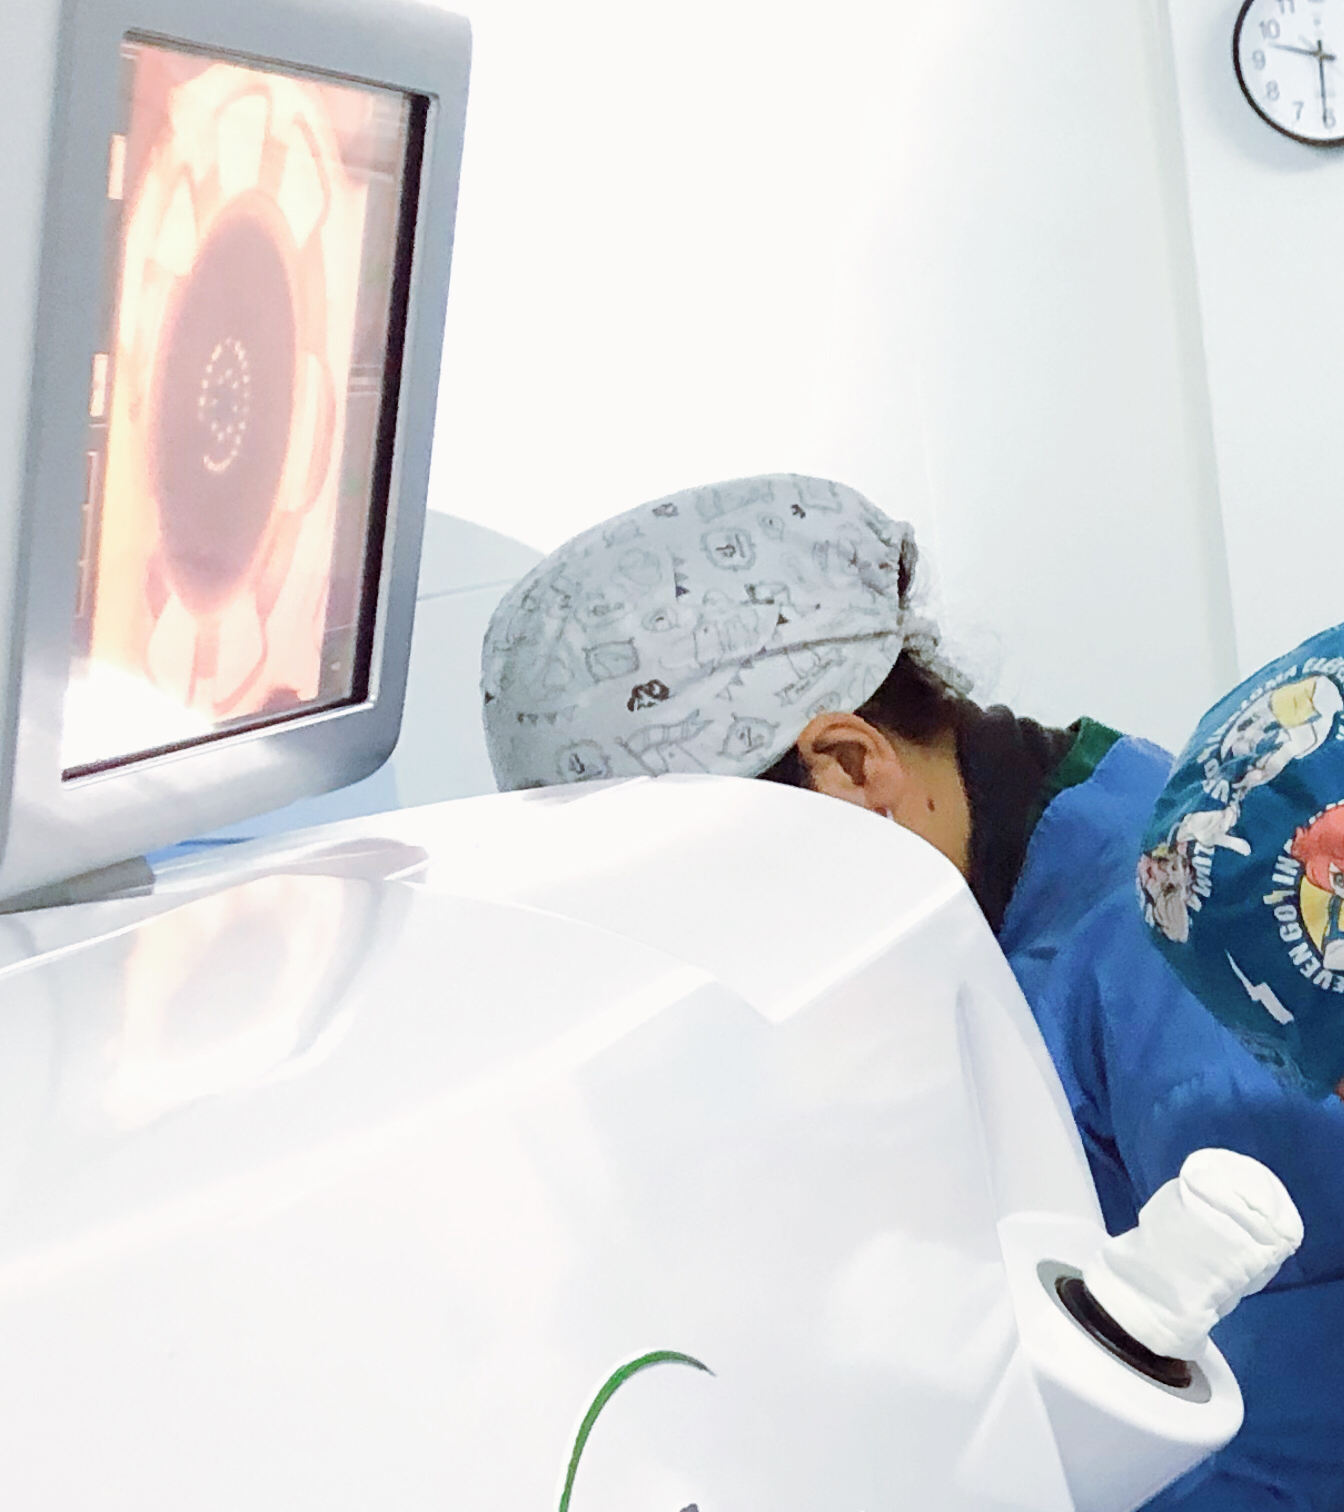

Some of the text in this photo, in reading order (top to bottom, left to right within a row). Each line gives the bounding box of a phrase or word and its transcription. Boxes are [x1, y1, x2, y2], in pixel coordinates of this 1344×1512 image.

[1259, 18, 1281, 39] 10
[1252, 50, 1266, 70] 9
[1265, 80, 1280, 101] 8
[1293, 101, 1304, 120] 7
[1273, 904, 1302, 942] GO
